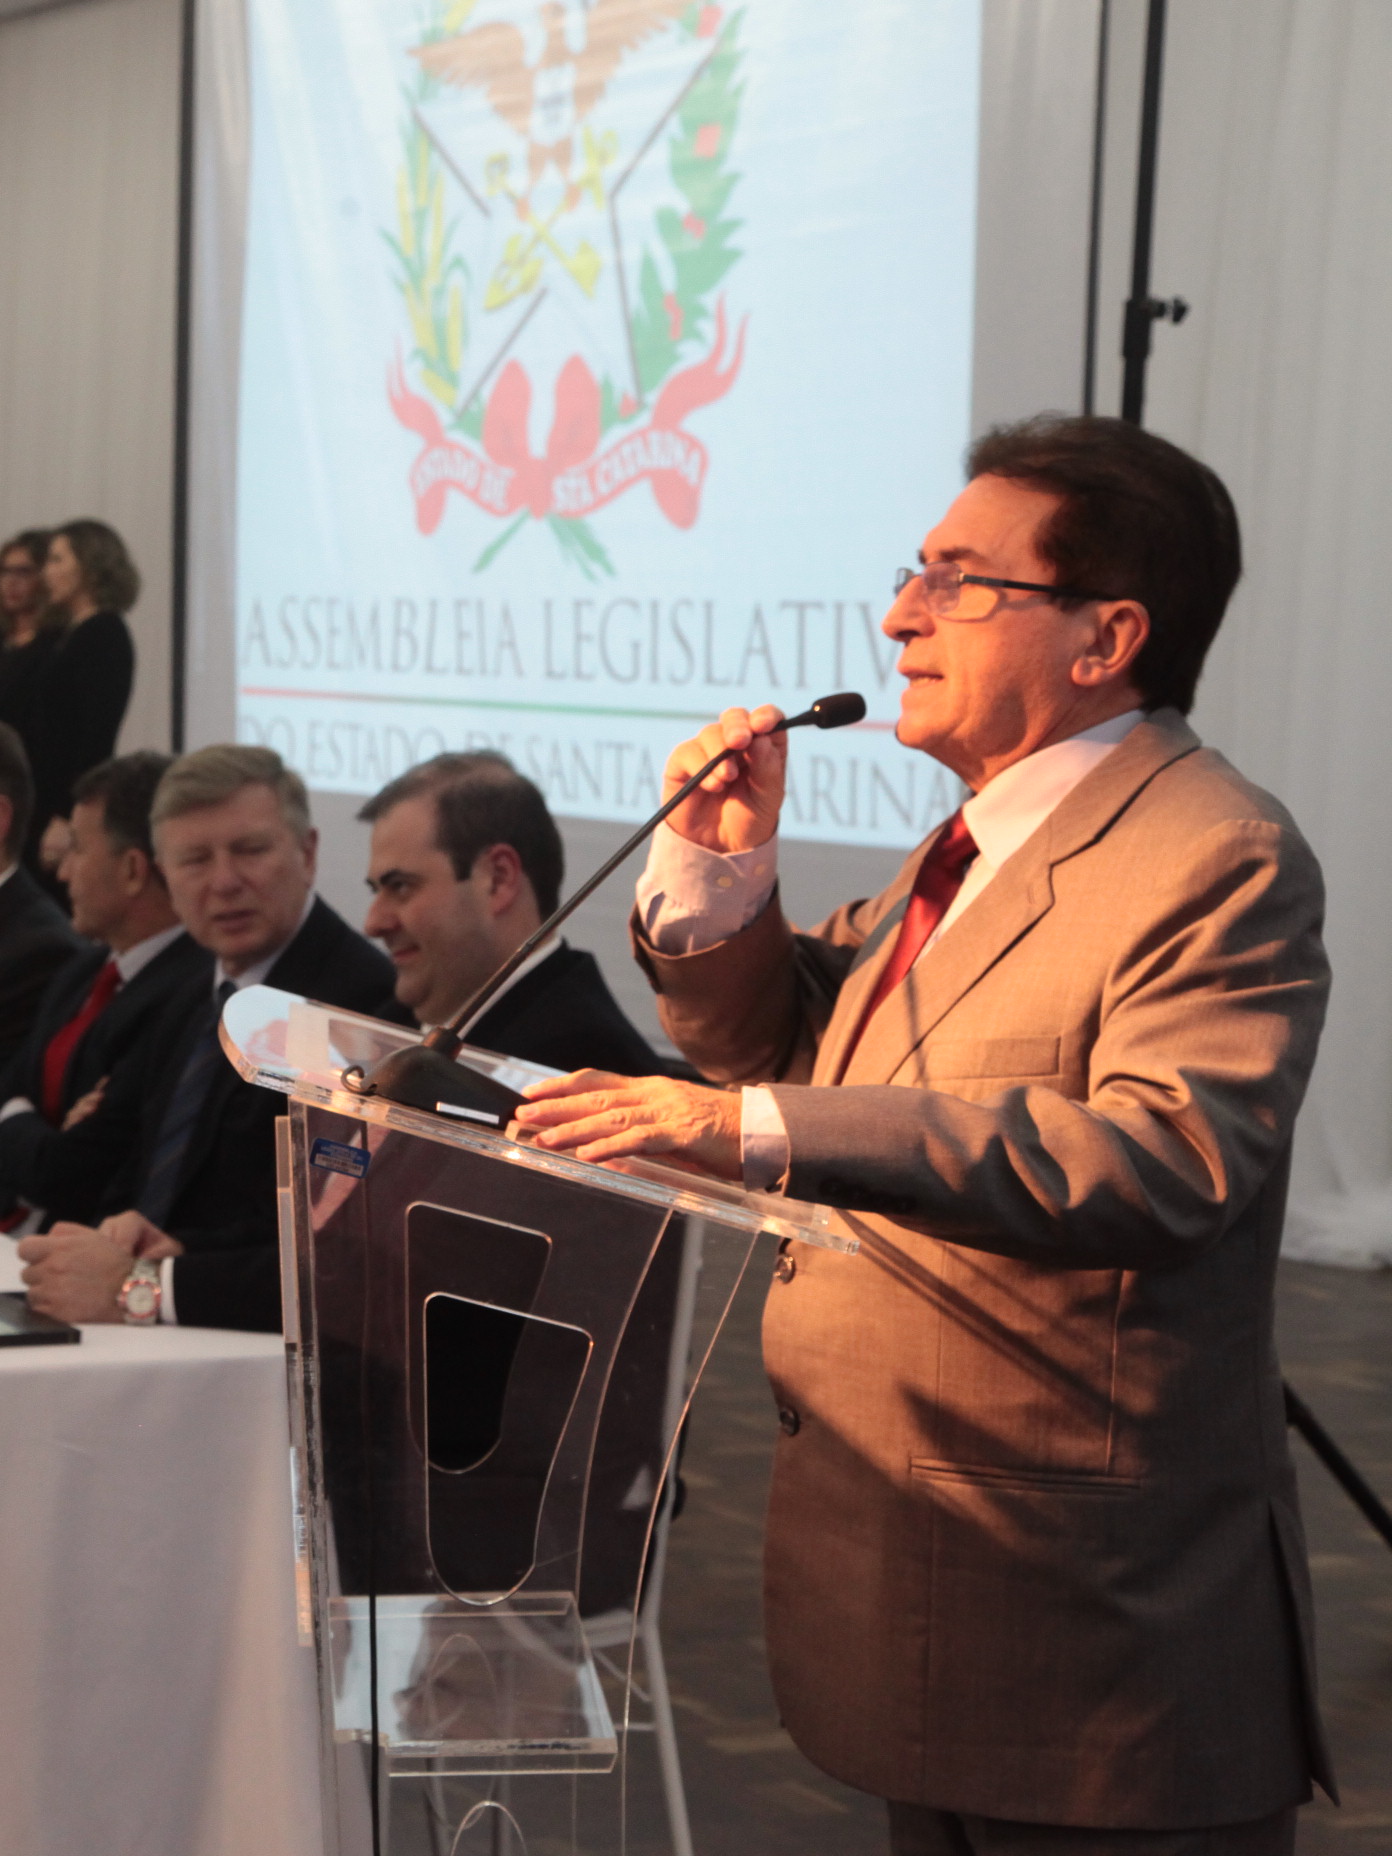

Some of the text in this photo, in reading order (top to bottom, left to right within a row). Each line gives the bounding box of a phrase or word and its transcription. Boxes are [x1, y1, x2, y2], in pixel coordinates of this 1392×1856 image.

[594, 428, 703, 488] CATARINA
[240, 594, 898, 691] ASSEMBLEIA LEGISLATIV
[307, 719, 446, 780] ESTADO
[525, 733, 663, 806] SANTA
